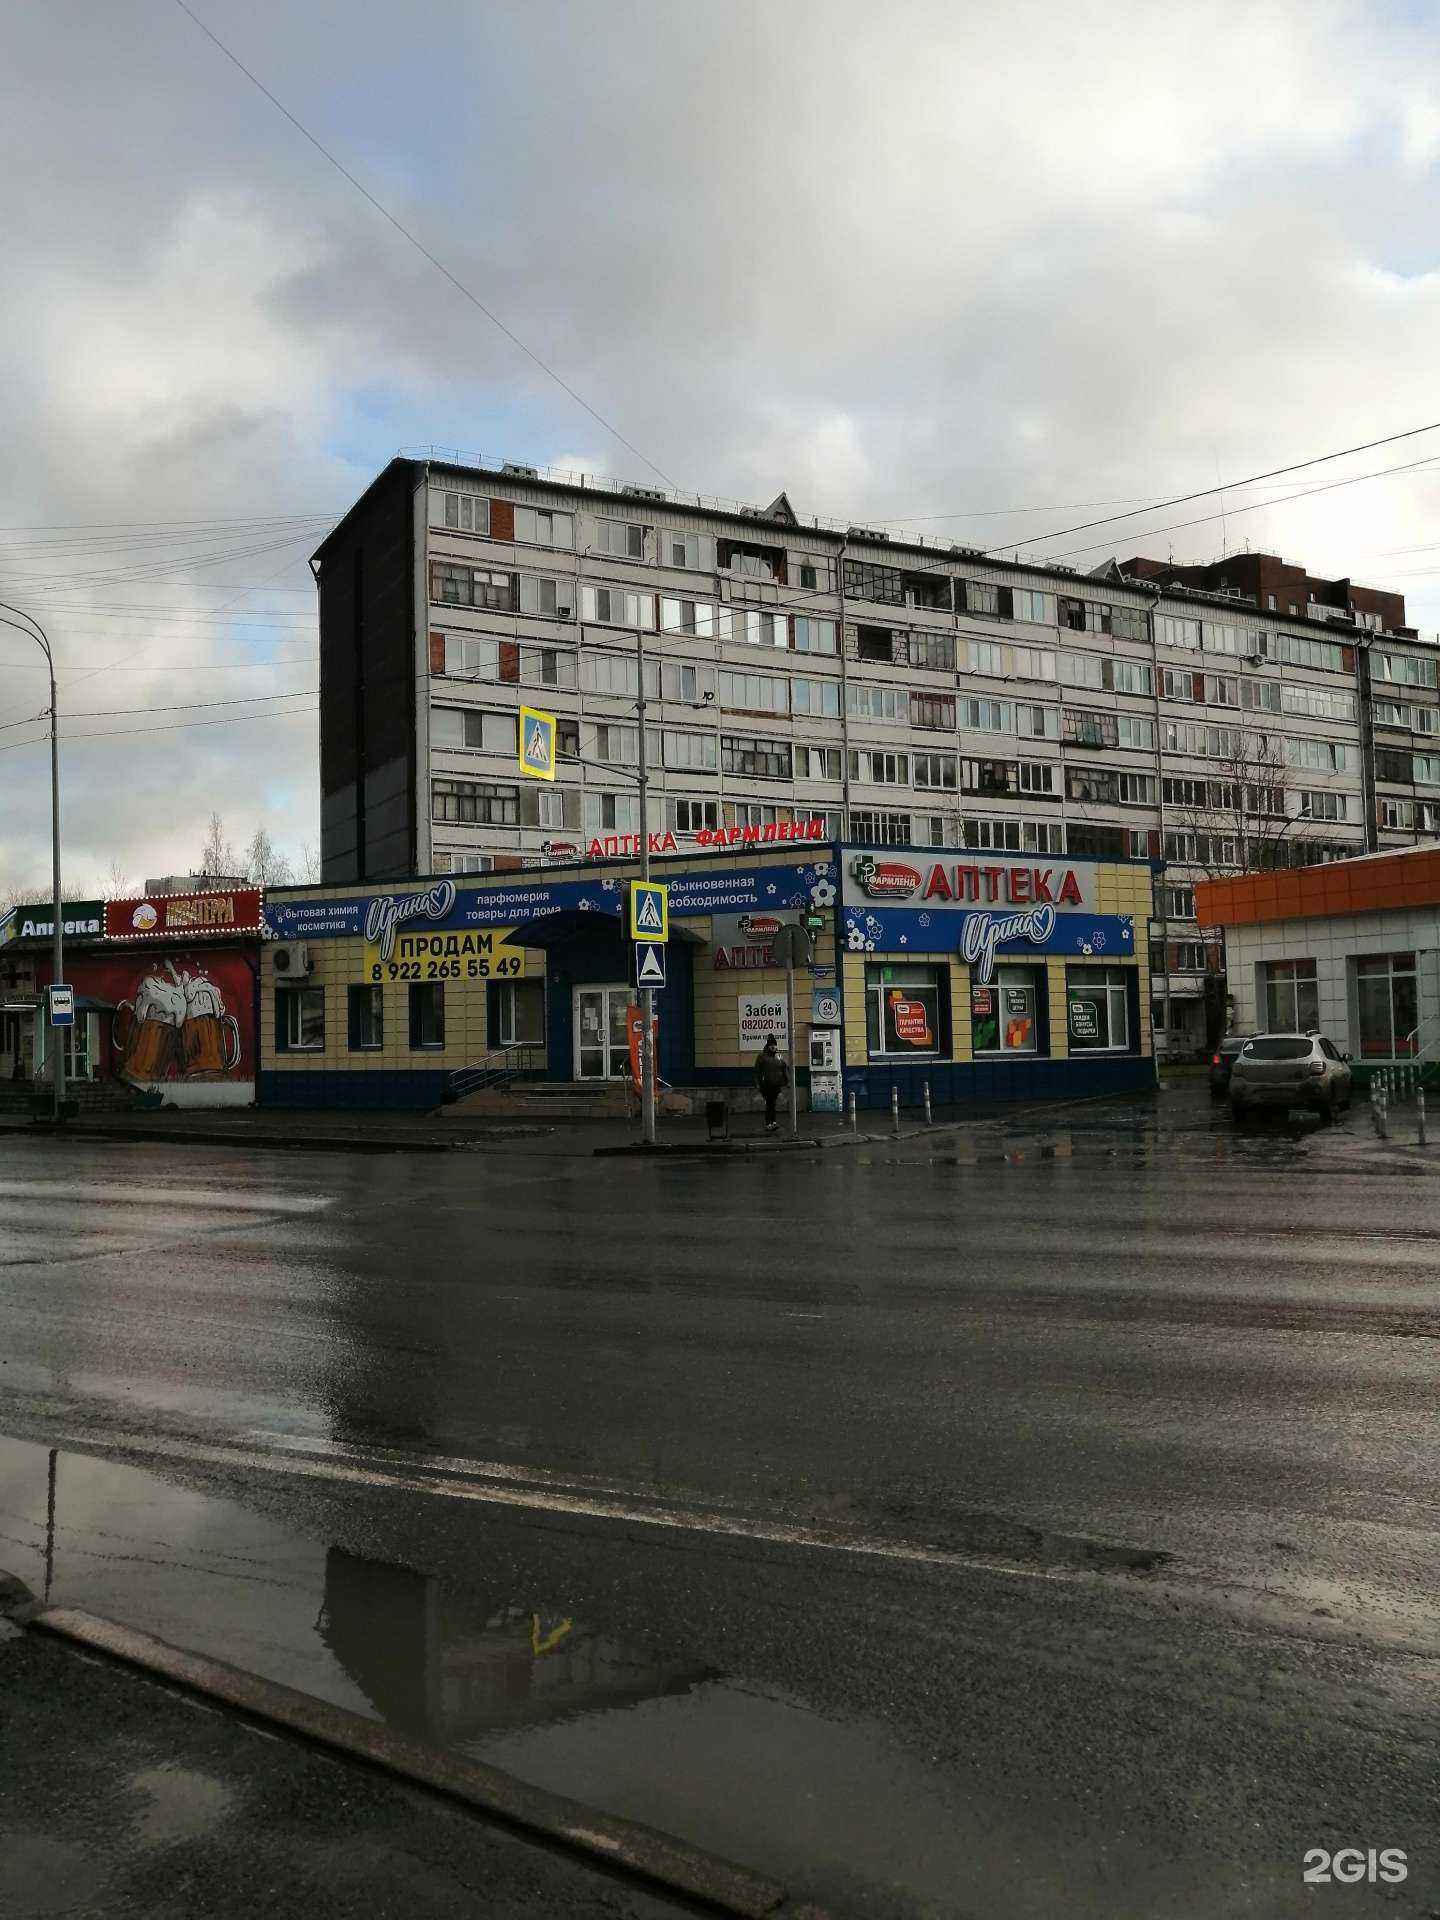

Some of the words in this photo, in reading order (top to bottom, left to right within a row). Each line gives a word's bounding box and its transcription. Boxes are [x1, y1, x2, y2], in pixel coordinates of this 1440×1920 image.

[695, 819, 825, 847] ФАРМЛЕНД
[923, 863, 1083, 904] АПТЕКА
[476, 891, 551, 906] парфюмерия
[668, 894, 759, 908] еобходимость
[286, 908, 326, 919] бытовая
[328, 905, 359, 916] химия
[466, 909, 506, 921] товары
[508, 908, 530, 919] для
[532, 904, 562, 917] дома
[297, 920, 347, 931] косметика
[363, 880, 456, 963] Ирина
[400, 933, 493, 958] ПРОДАМ
[963, 903, 1056, 984] Ирина
[371, 963, 382, 981] 8
[388, 962, 422, 980] 922
[427, 959, 461, 979] 265
[467, 958, 490, 977] 55
[496, 956, 521, 976] 49
[745, 1003, 782, 1017] Забей
[823, 1002, 832, 1011] 24
[741, 1019, 786, 1030] 082020.ru
